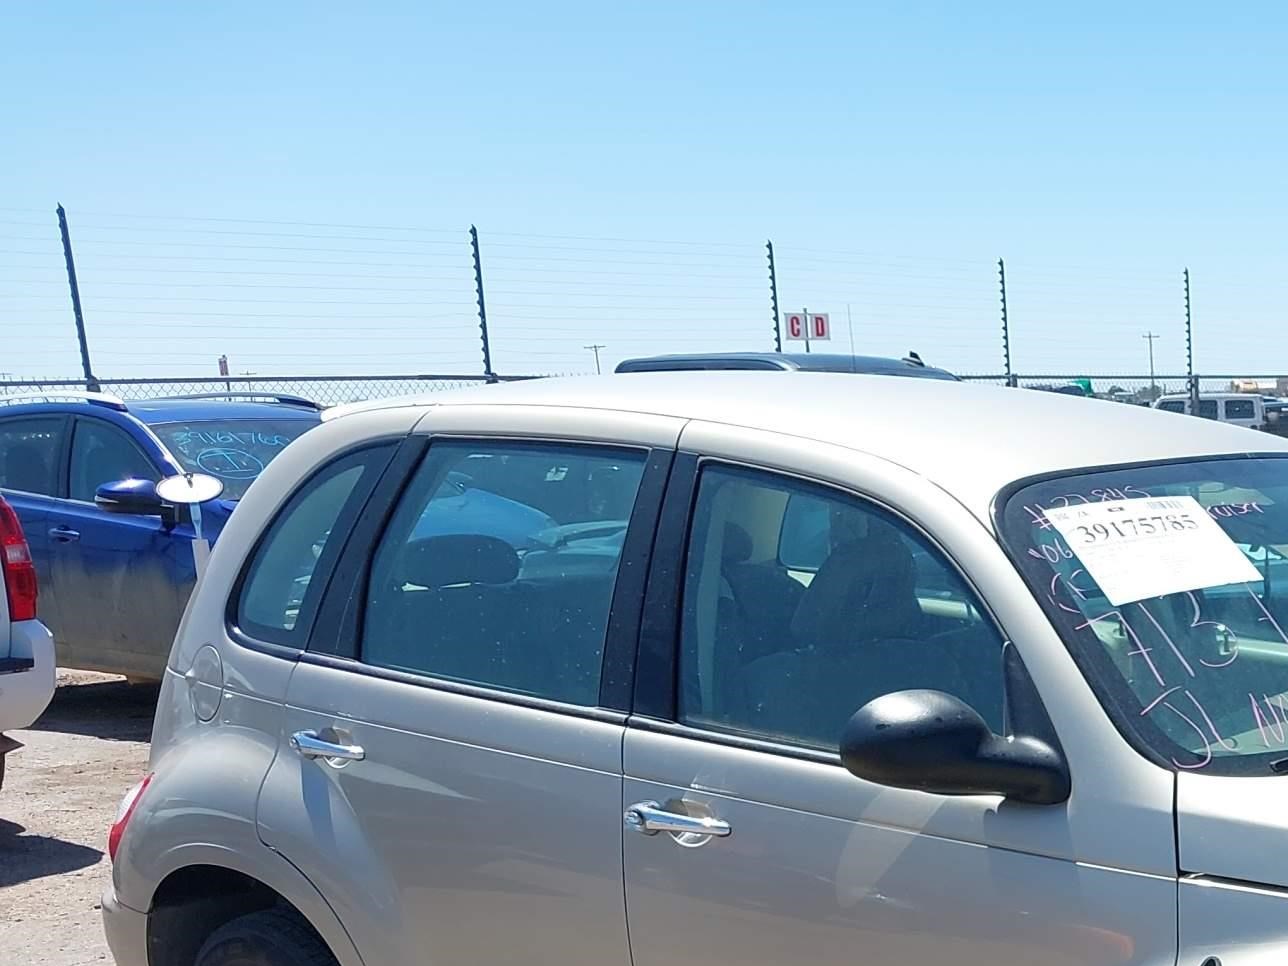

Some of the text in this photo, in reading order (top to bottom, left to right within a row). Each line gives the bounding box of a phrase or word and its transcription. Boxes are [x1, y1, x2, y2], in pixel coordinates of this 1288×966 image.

[790, 316, 825, 337] C D
[1076, 513, 1200, 544] 39175785
